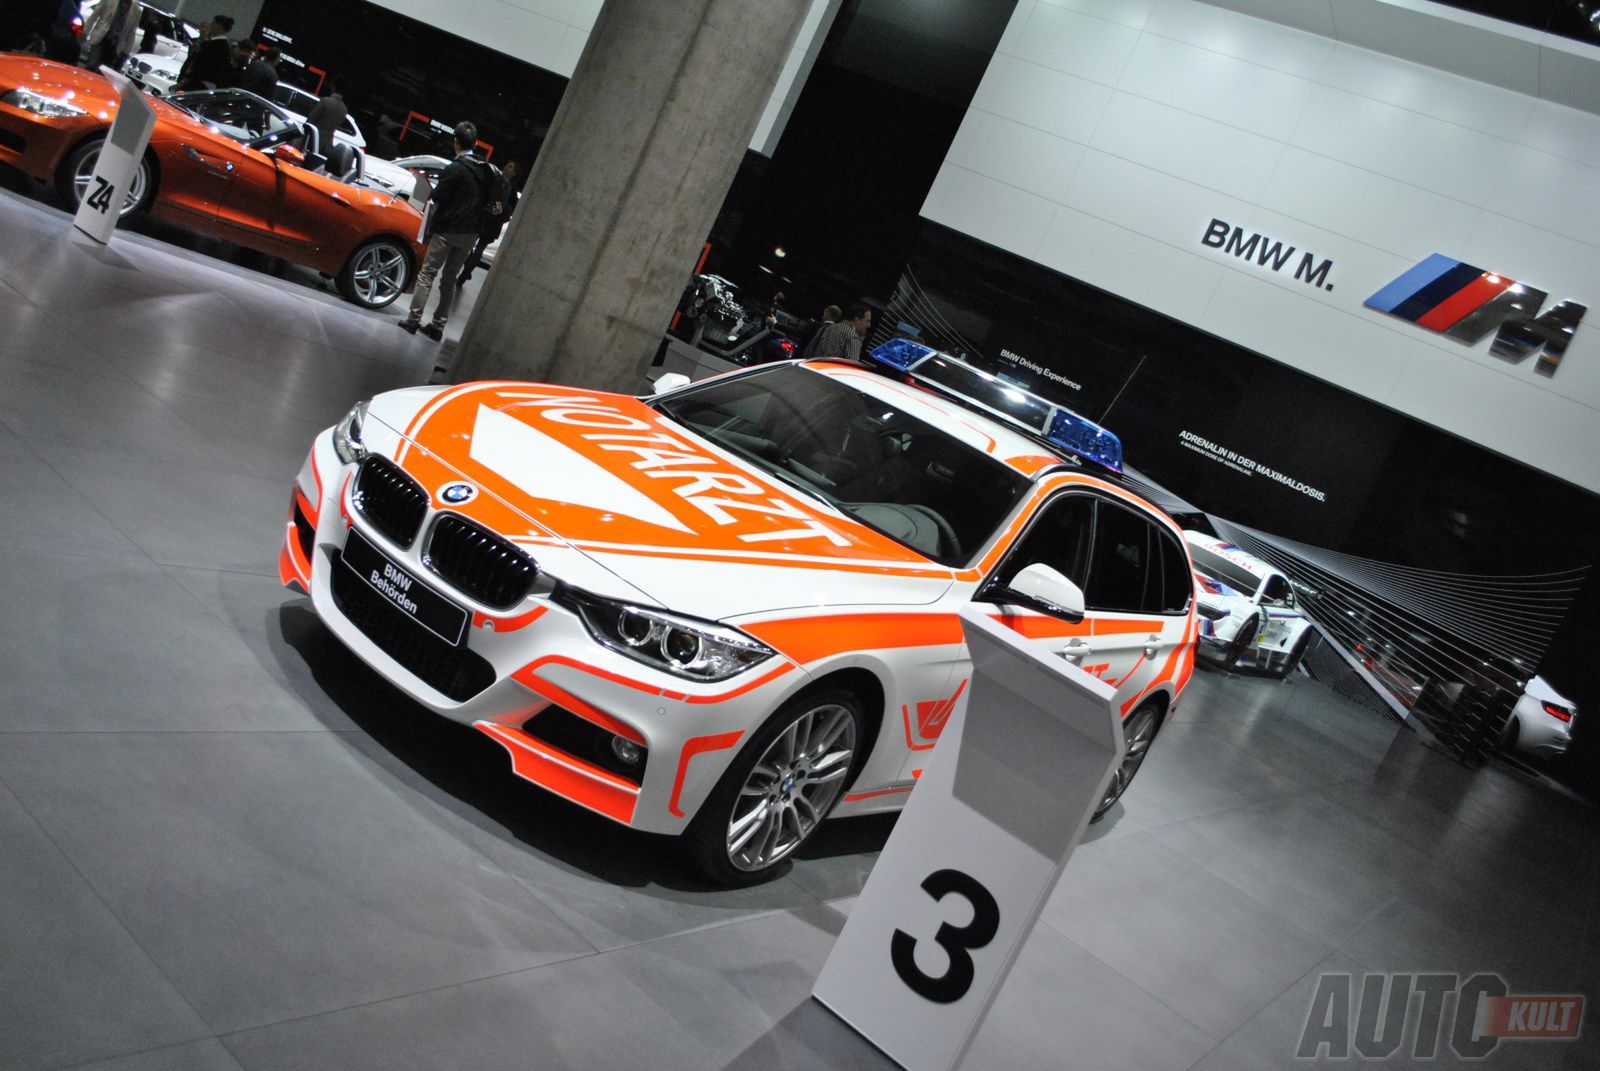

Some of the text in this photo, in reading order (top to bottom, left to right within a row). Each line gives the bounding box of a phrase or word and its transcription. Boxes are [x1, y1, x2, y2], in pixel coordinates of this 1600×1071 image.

[87, 175, 115, 215] Z4
[1201, 218, 1335, 292] BMW M.
[1000, 349, 1020, 362] BMW
[1019, 357, 1043, 374] Driving
[1043, 368, 1082, 391] Experience
[496, 392, 853, 548] NOTARZT
[1179, 430, 1325, 502] ADRENALIN IN DER MAXIMALDOSIS.
[370, 570, 418, 614] Behörden
[384, 563, 413, 591] BMW
[890, 868, 1000, 1004] 3
